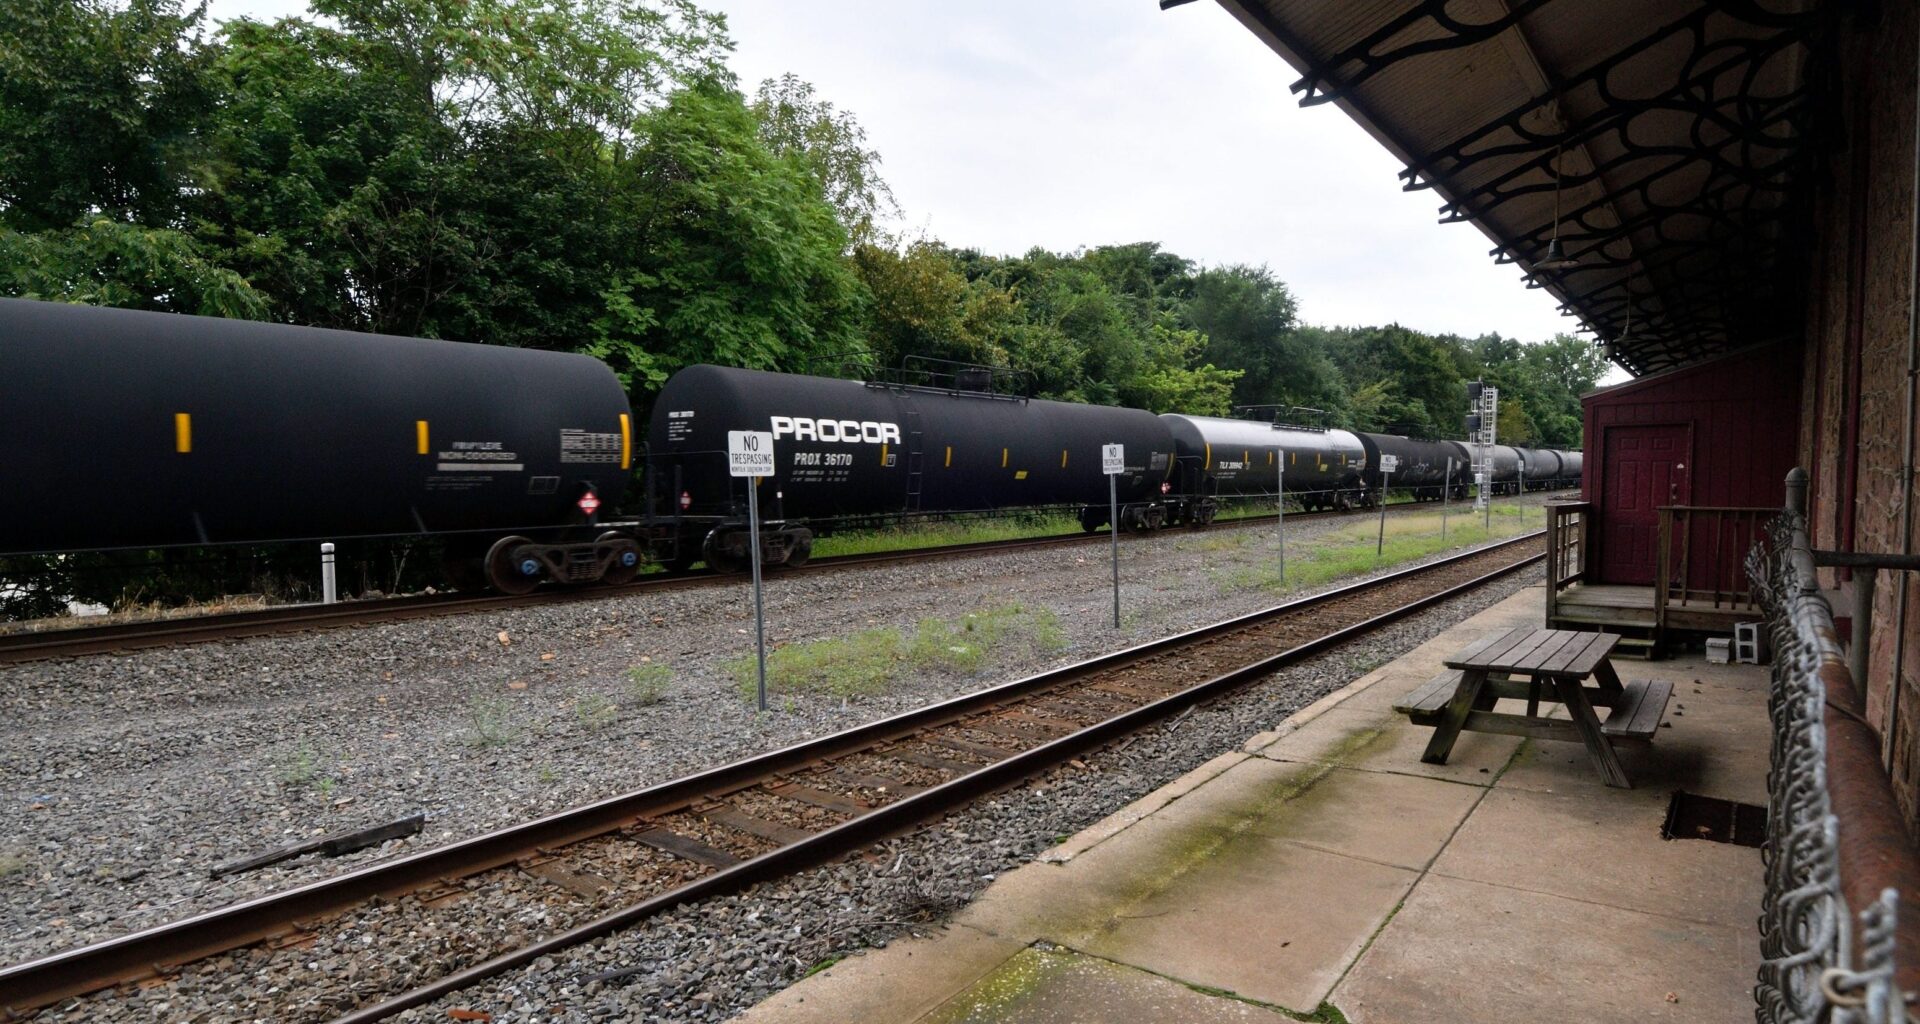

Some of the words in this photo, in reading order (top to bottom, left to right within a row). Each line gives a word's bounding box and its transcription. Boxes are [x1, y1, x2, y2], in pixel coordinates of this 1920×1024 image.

[770, 416, 901, 444] PROCOR
[744, 435, 758, 451] NO
[731, 453, 772, 465] TRESPASSING
[794, 452, 821, 465] PROX
[824, 453, 853, 466] 36170
[1109, 447, 1117, 458] NO
